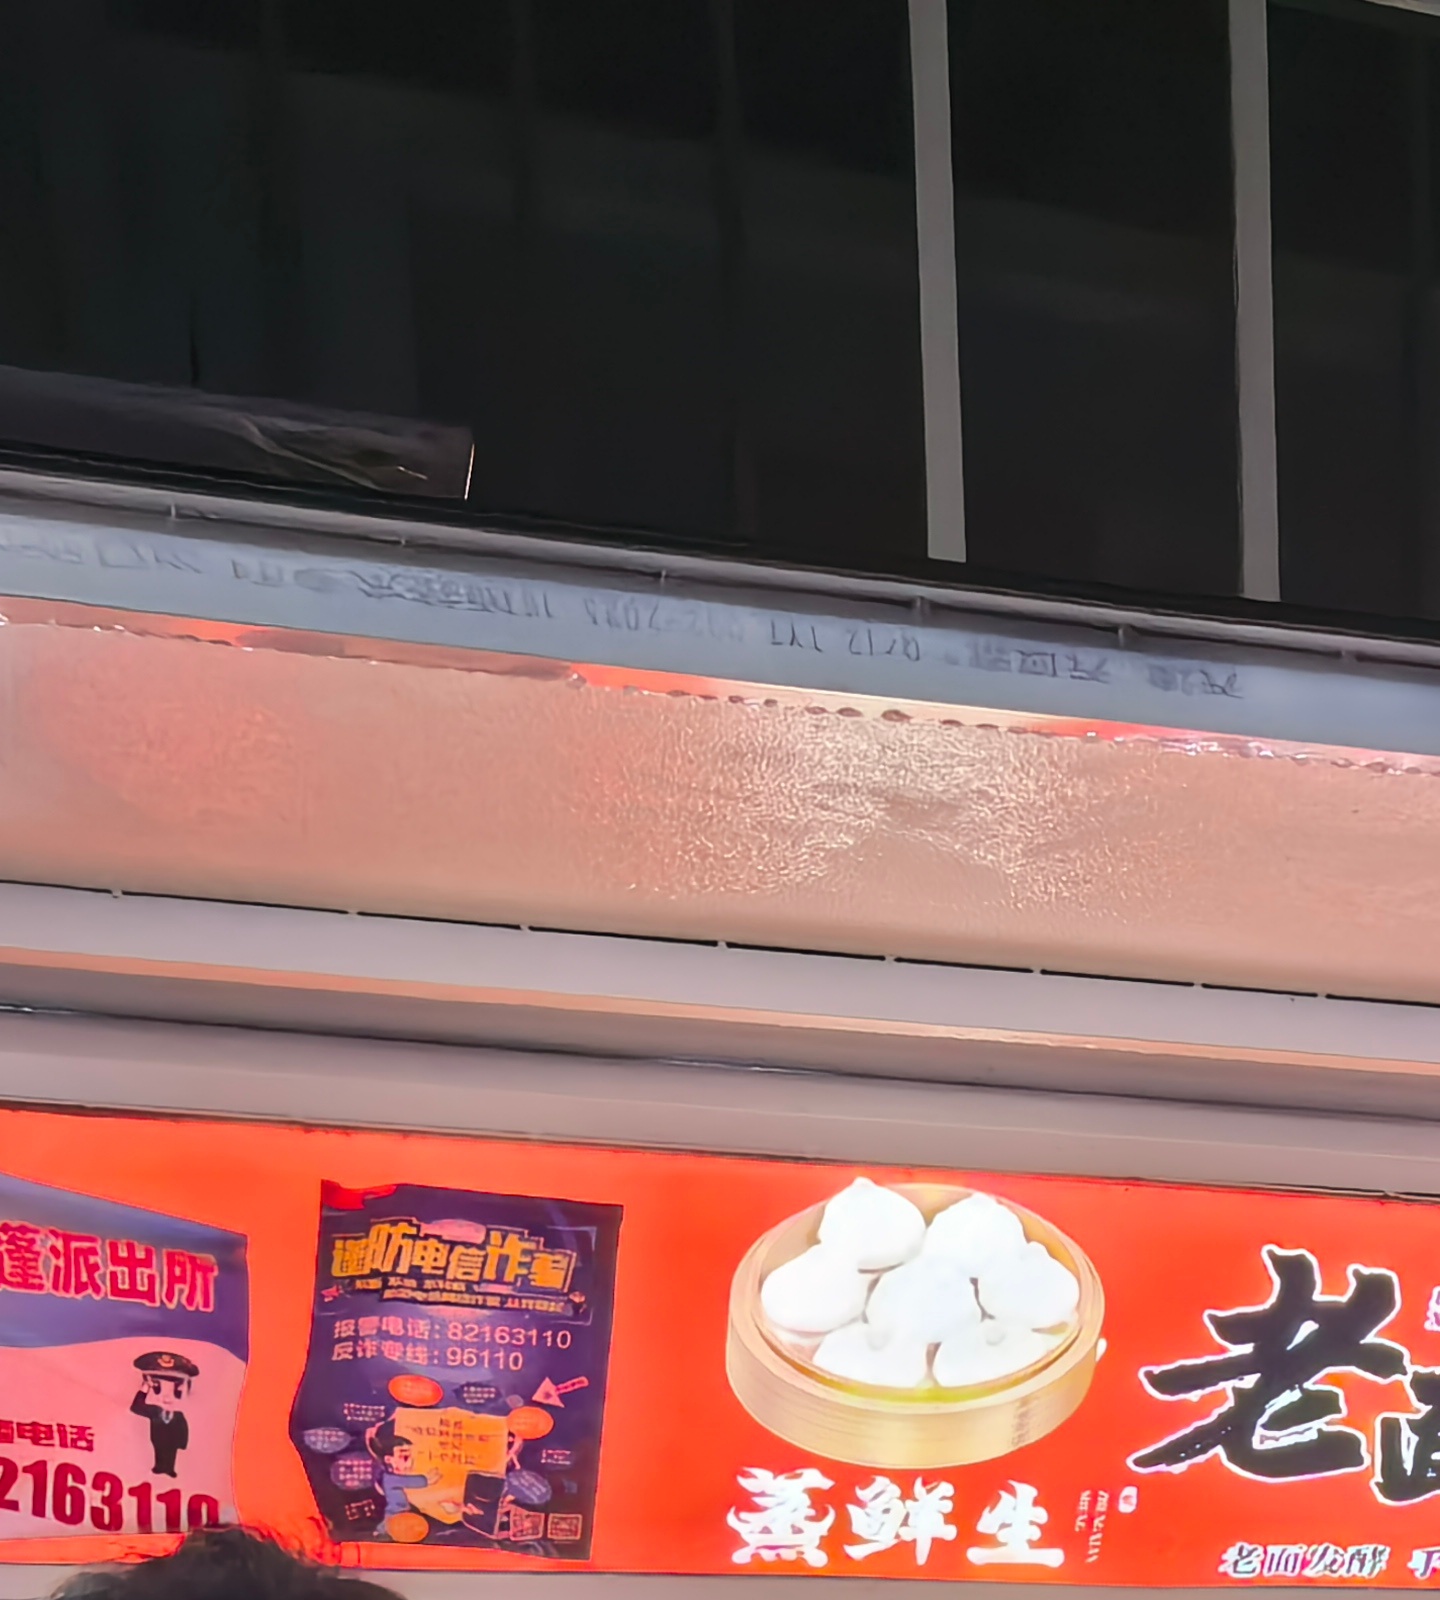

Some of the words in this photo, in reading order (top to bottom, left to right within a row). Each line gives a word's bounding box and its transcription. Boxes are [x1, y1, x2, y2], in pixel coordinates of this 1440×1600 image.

[727, 1467, 1064, 1568] 蒸鲜生
[1219, 1541, 1391, 1579] 老面发酵
